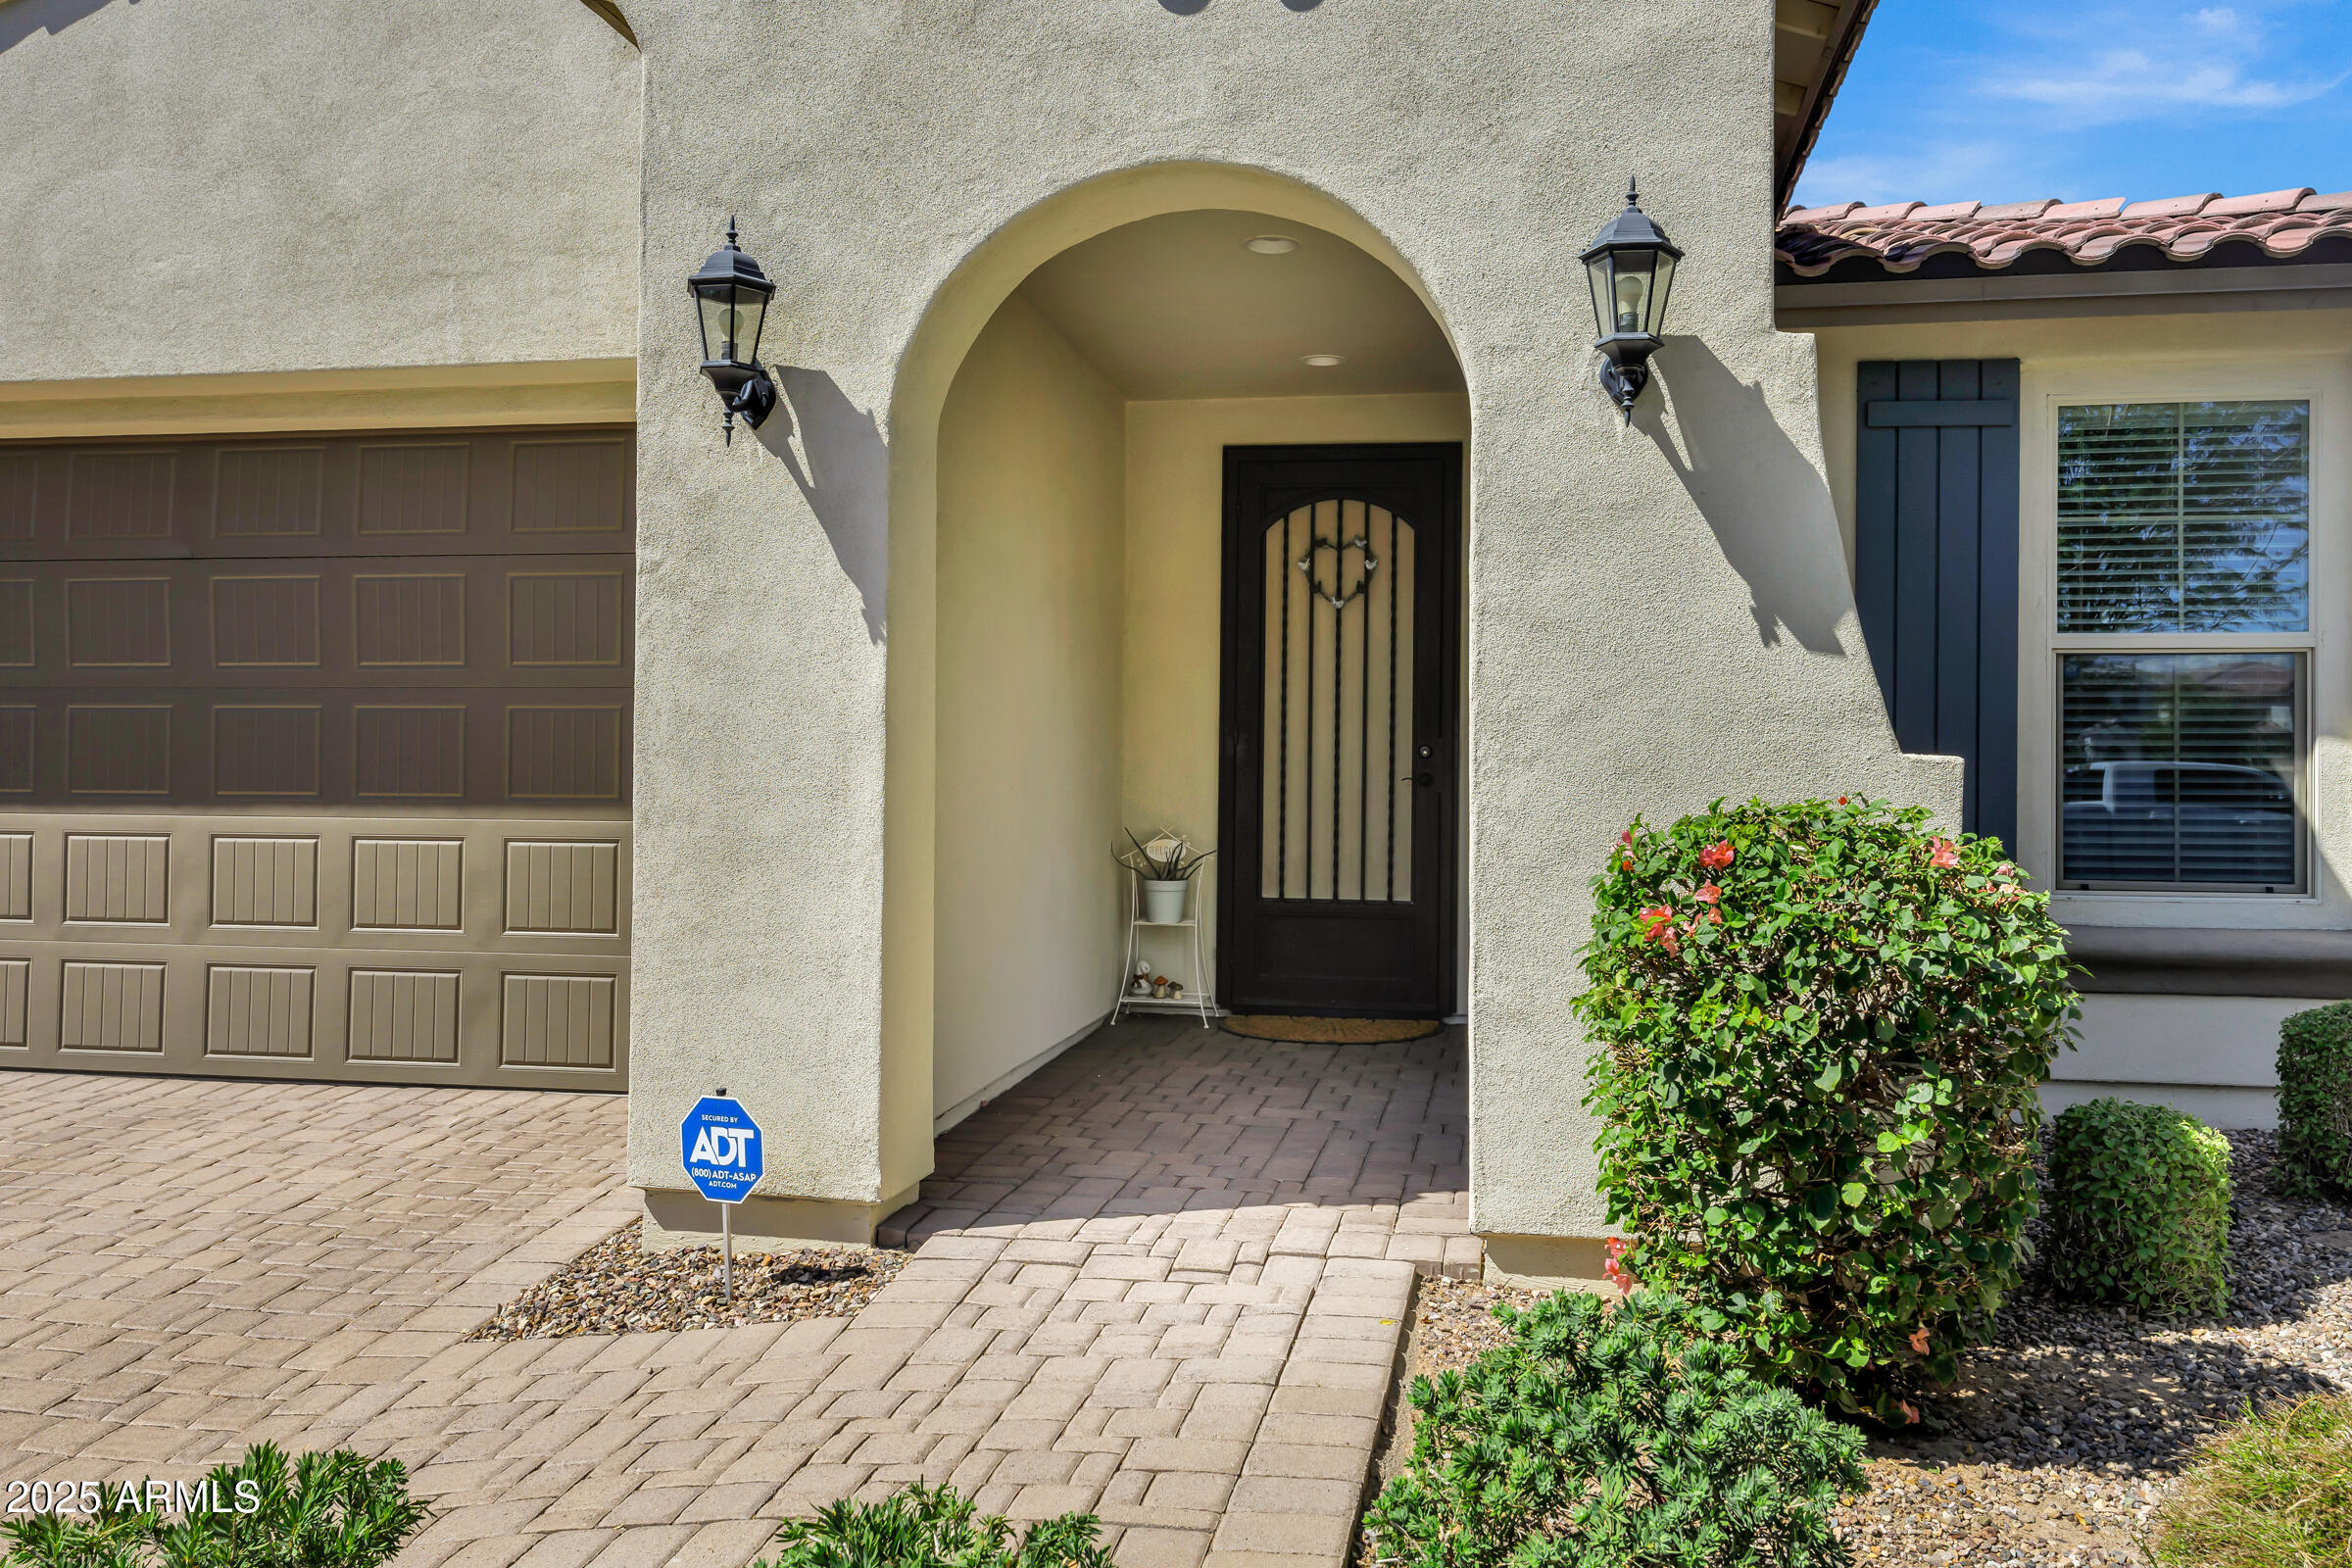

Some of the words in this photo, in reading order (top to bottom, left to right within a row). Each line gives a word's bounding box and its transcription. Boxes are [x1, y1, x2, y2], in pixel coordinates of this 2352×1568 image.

[689, 1126, 755, 1168] ADT
[691, 1167, 711, 1179] (800)
[712, 1170, 757, 1182] ADT-ASAP
